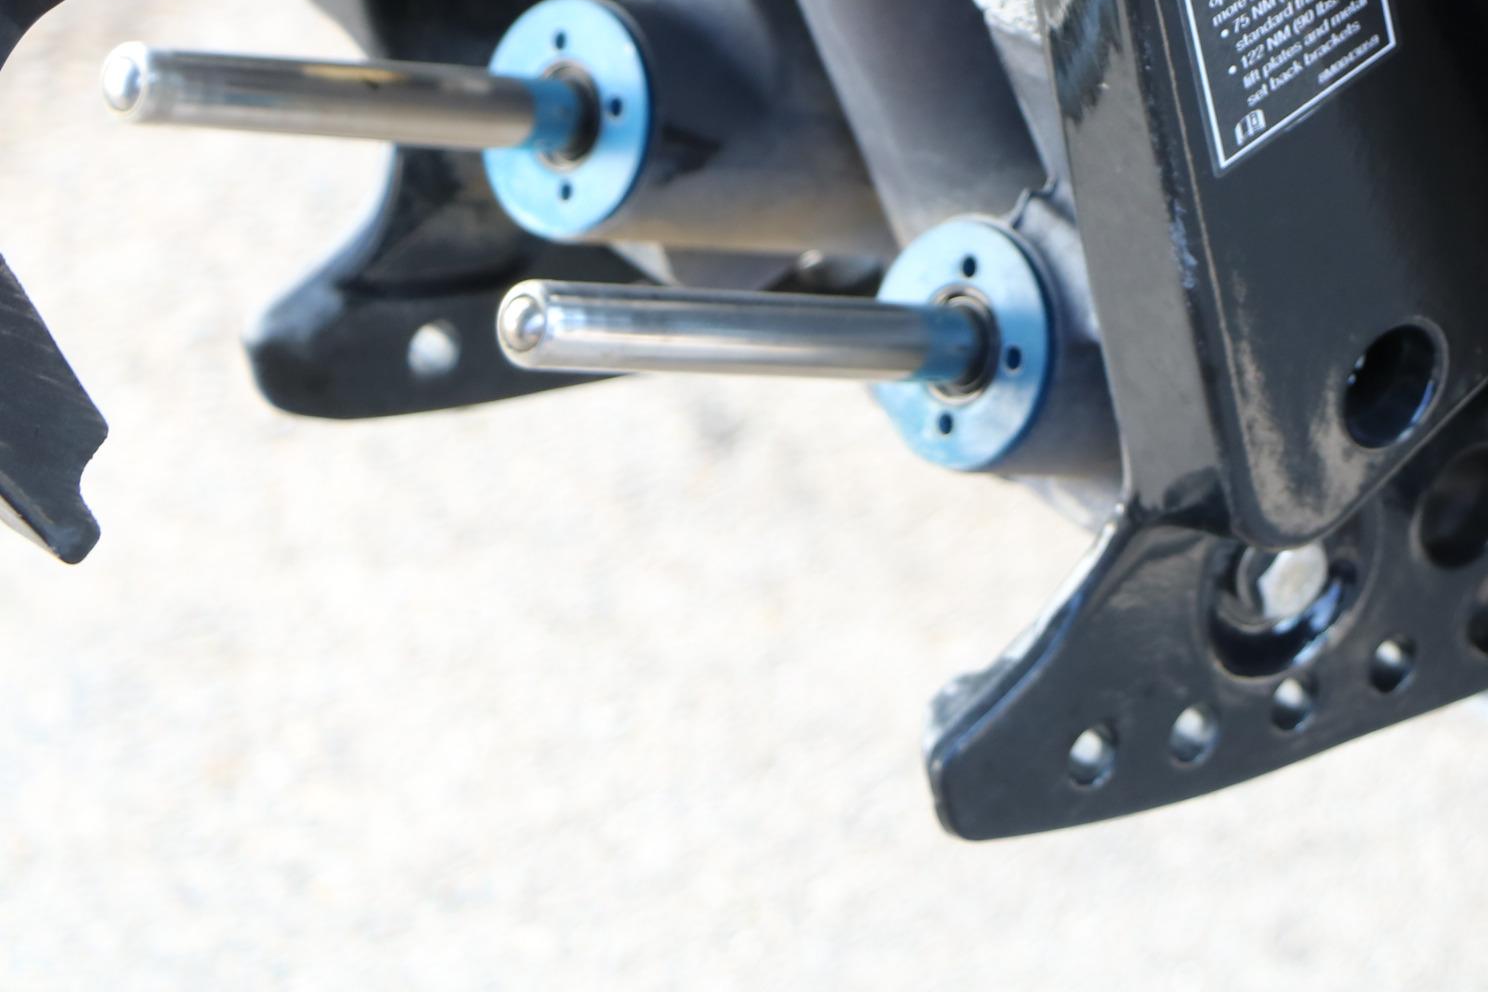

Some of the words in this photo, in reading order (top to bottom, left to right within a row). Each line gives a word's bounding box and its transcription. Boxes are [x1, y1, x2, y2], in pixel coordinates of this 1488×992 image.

[1232, 13, 1249, 32] 75
[1234, 3, 1292, 51] standard
[1240, 44, 1264, 68] 122
[1266, 25, 1291, 49] NM
[1246, 84, 1267, 105] set
[1268, 59, 1302, 89] back
[1303, 17, 1360, 64] brackets
[1262, 39, 1302, 75] plates
[1303, 20, 1328, 44] and
